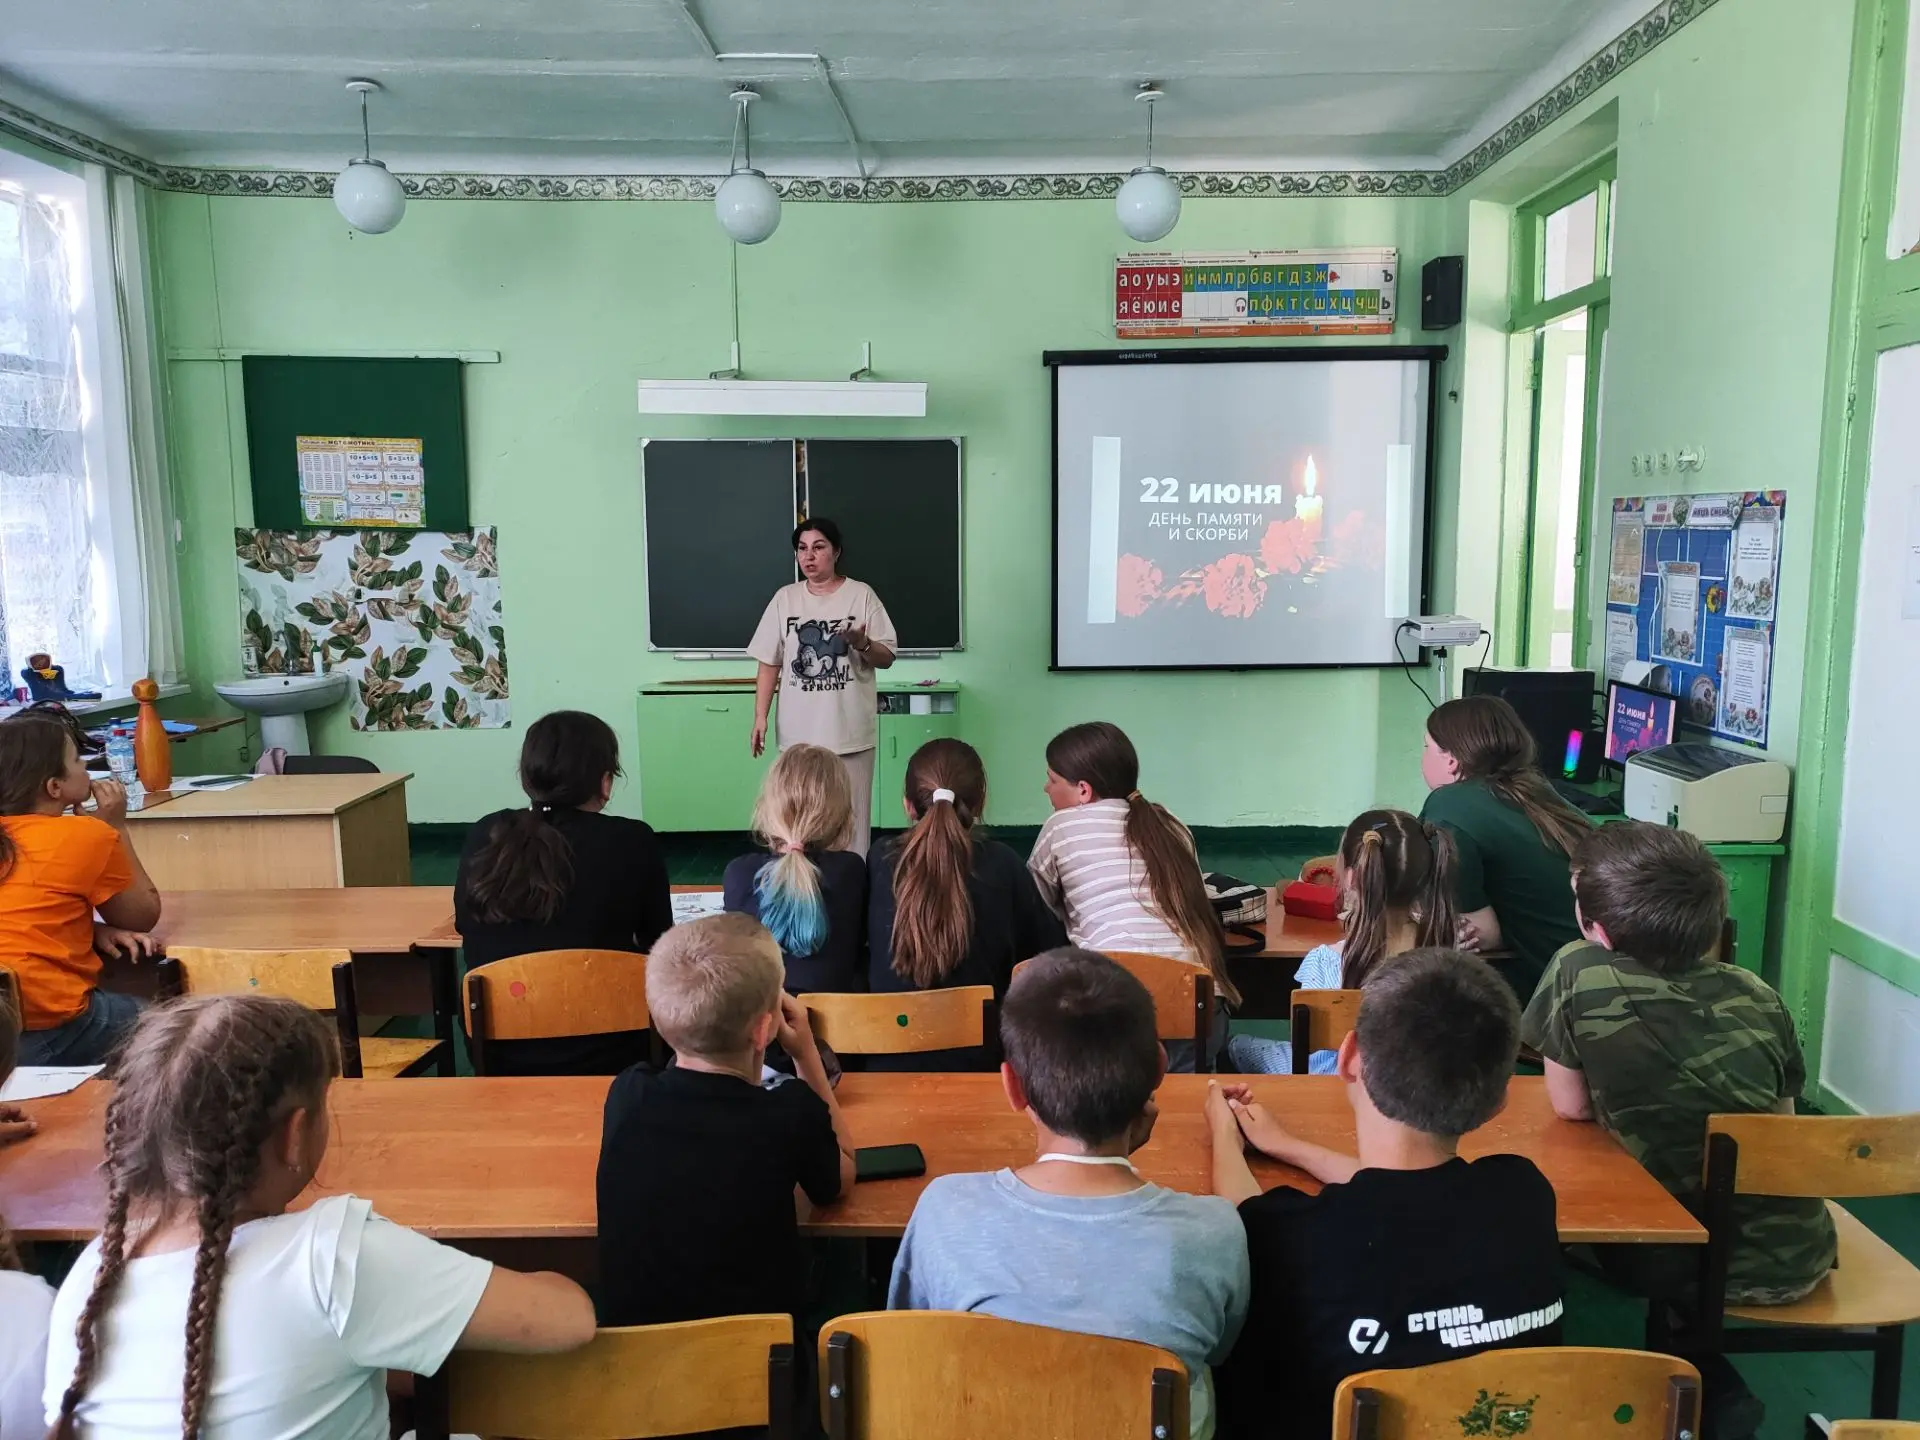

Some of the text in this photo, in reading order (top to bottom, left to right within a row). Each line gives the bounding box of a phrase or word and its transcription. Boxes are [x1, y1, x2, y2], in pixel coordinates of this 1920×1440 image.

[1139, 476, 1282, 504] 22 июня
[1148, 512, 1263, 527] ДЕНЬ ПАМЯТИ
[1168, 527, 1249, 541] И СКОРБИ
[801, 682, 847, 692] 4FRONT
[1617, 702, 1626, 715] 22
[1407, 1304, 1484, 1333] СТАНЬ
